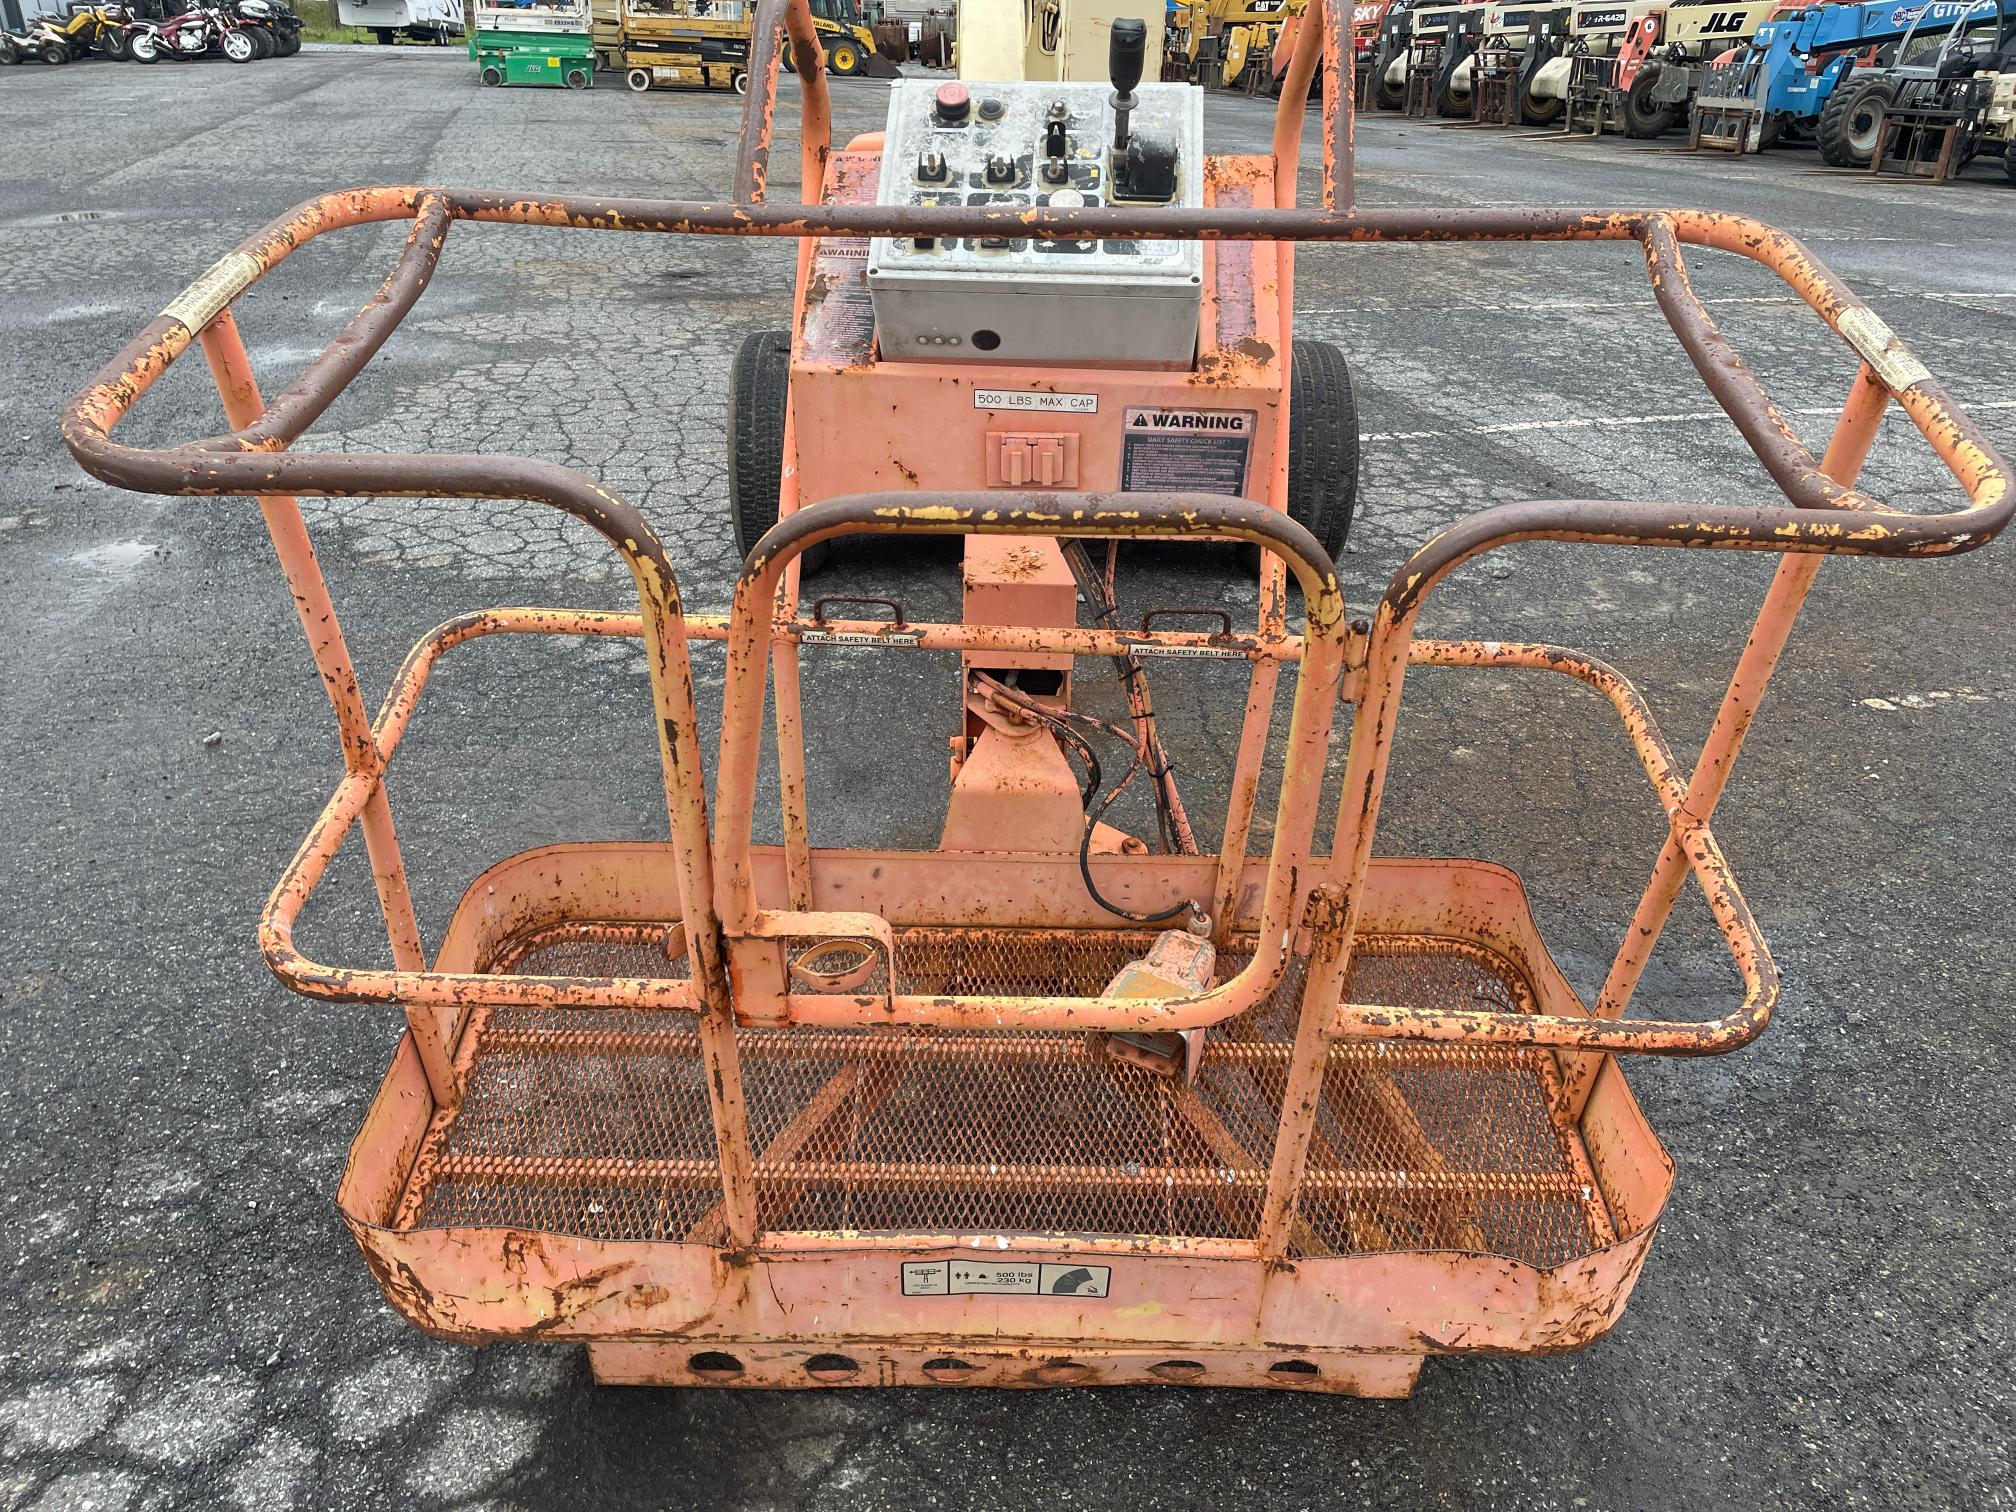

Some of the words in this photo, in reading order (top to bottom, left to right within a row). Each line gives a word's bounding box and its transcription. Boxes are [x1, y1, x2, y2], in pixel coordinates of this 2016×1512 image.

[1255, 1, 1269, 12] CAT
[1354, 5, 1383, 21] SKY
[1647, 22, 1652, 30] 6
[1699, 12, 1748, 34] JLG
[978, 395, 1001, 404] 500
[1009, 396, 1032, 406] LBS
[1040, 397, 1063, 407] MAX
[1070, 399, 1094, 408] CAP
[1153, 414, 1243, 430] WARNING
